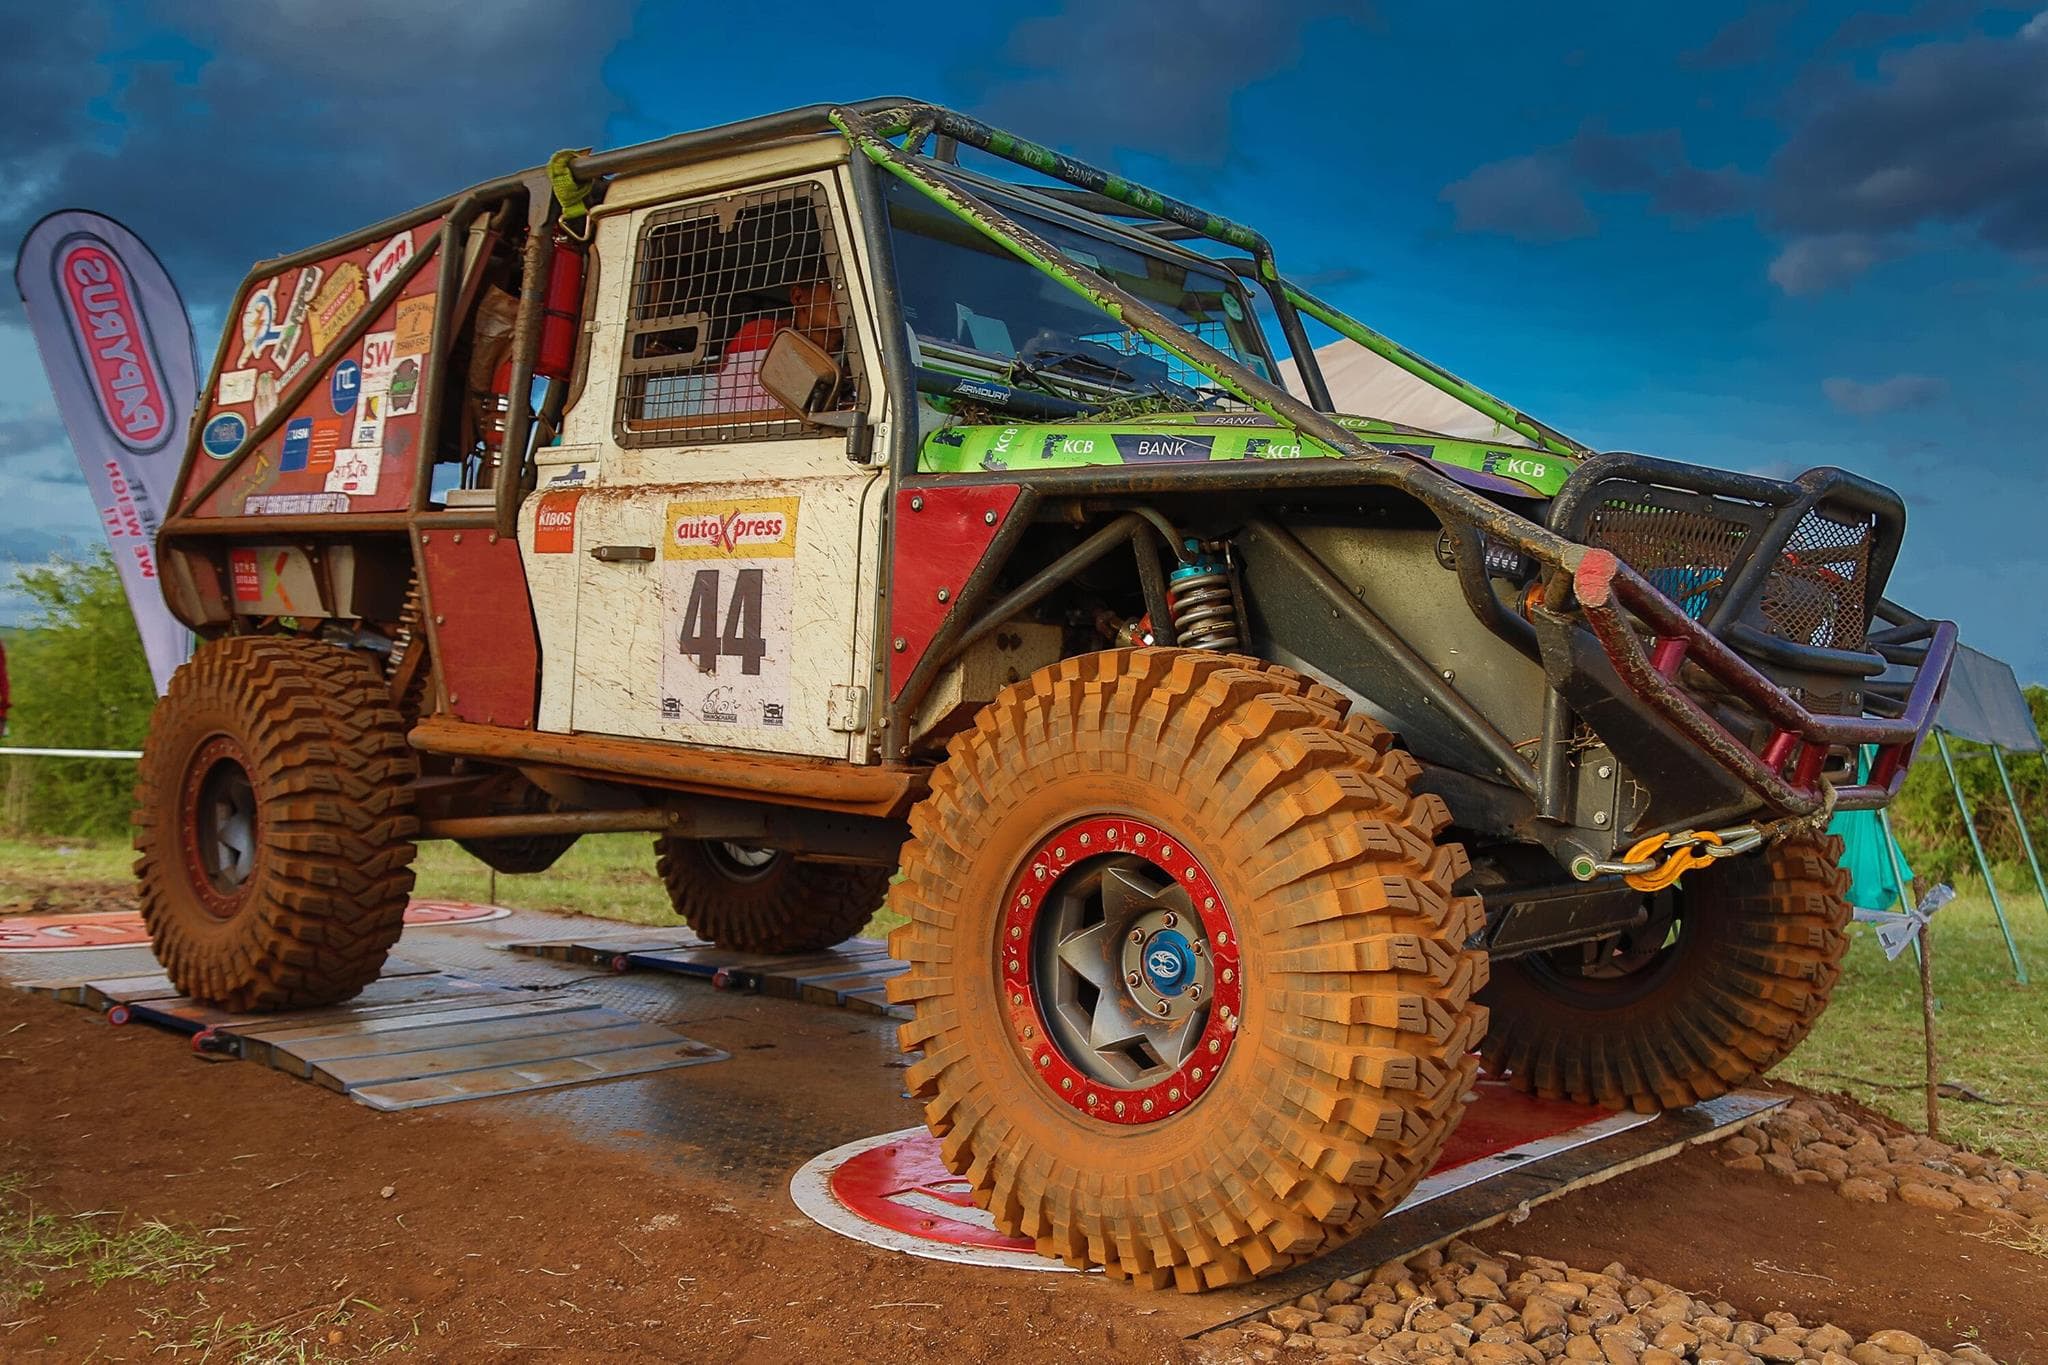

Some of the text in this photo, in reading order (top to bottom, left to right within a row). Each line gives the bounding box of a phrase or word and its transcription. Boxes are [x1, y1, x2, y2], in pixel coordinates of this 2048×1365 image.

[1066, 166, 1096, 185] BANK
[958, 383, 1010, 402] ARMOURY
[1338, 418, 1371, 428] KCB
[993, 427, 1018, 453] KCB
[1063, 440, 1301, 459] KCB BANK KCB
[1507, 459, 1546, 478] KCB
[538, 511, 573, 526] KIBOS
[677, 508, 783, 553] autoXpress
[680, 569, 766, 676] 44
